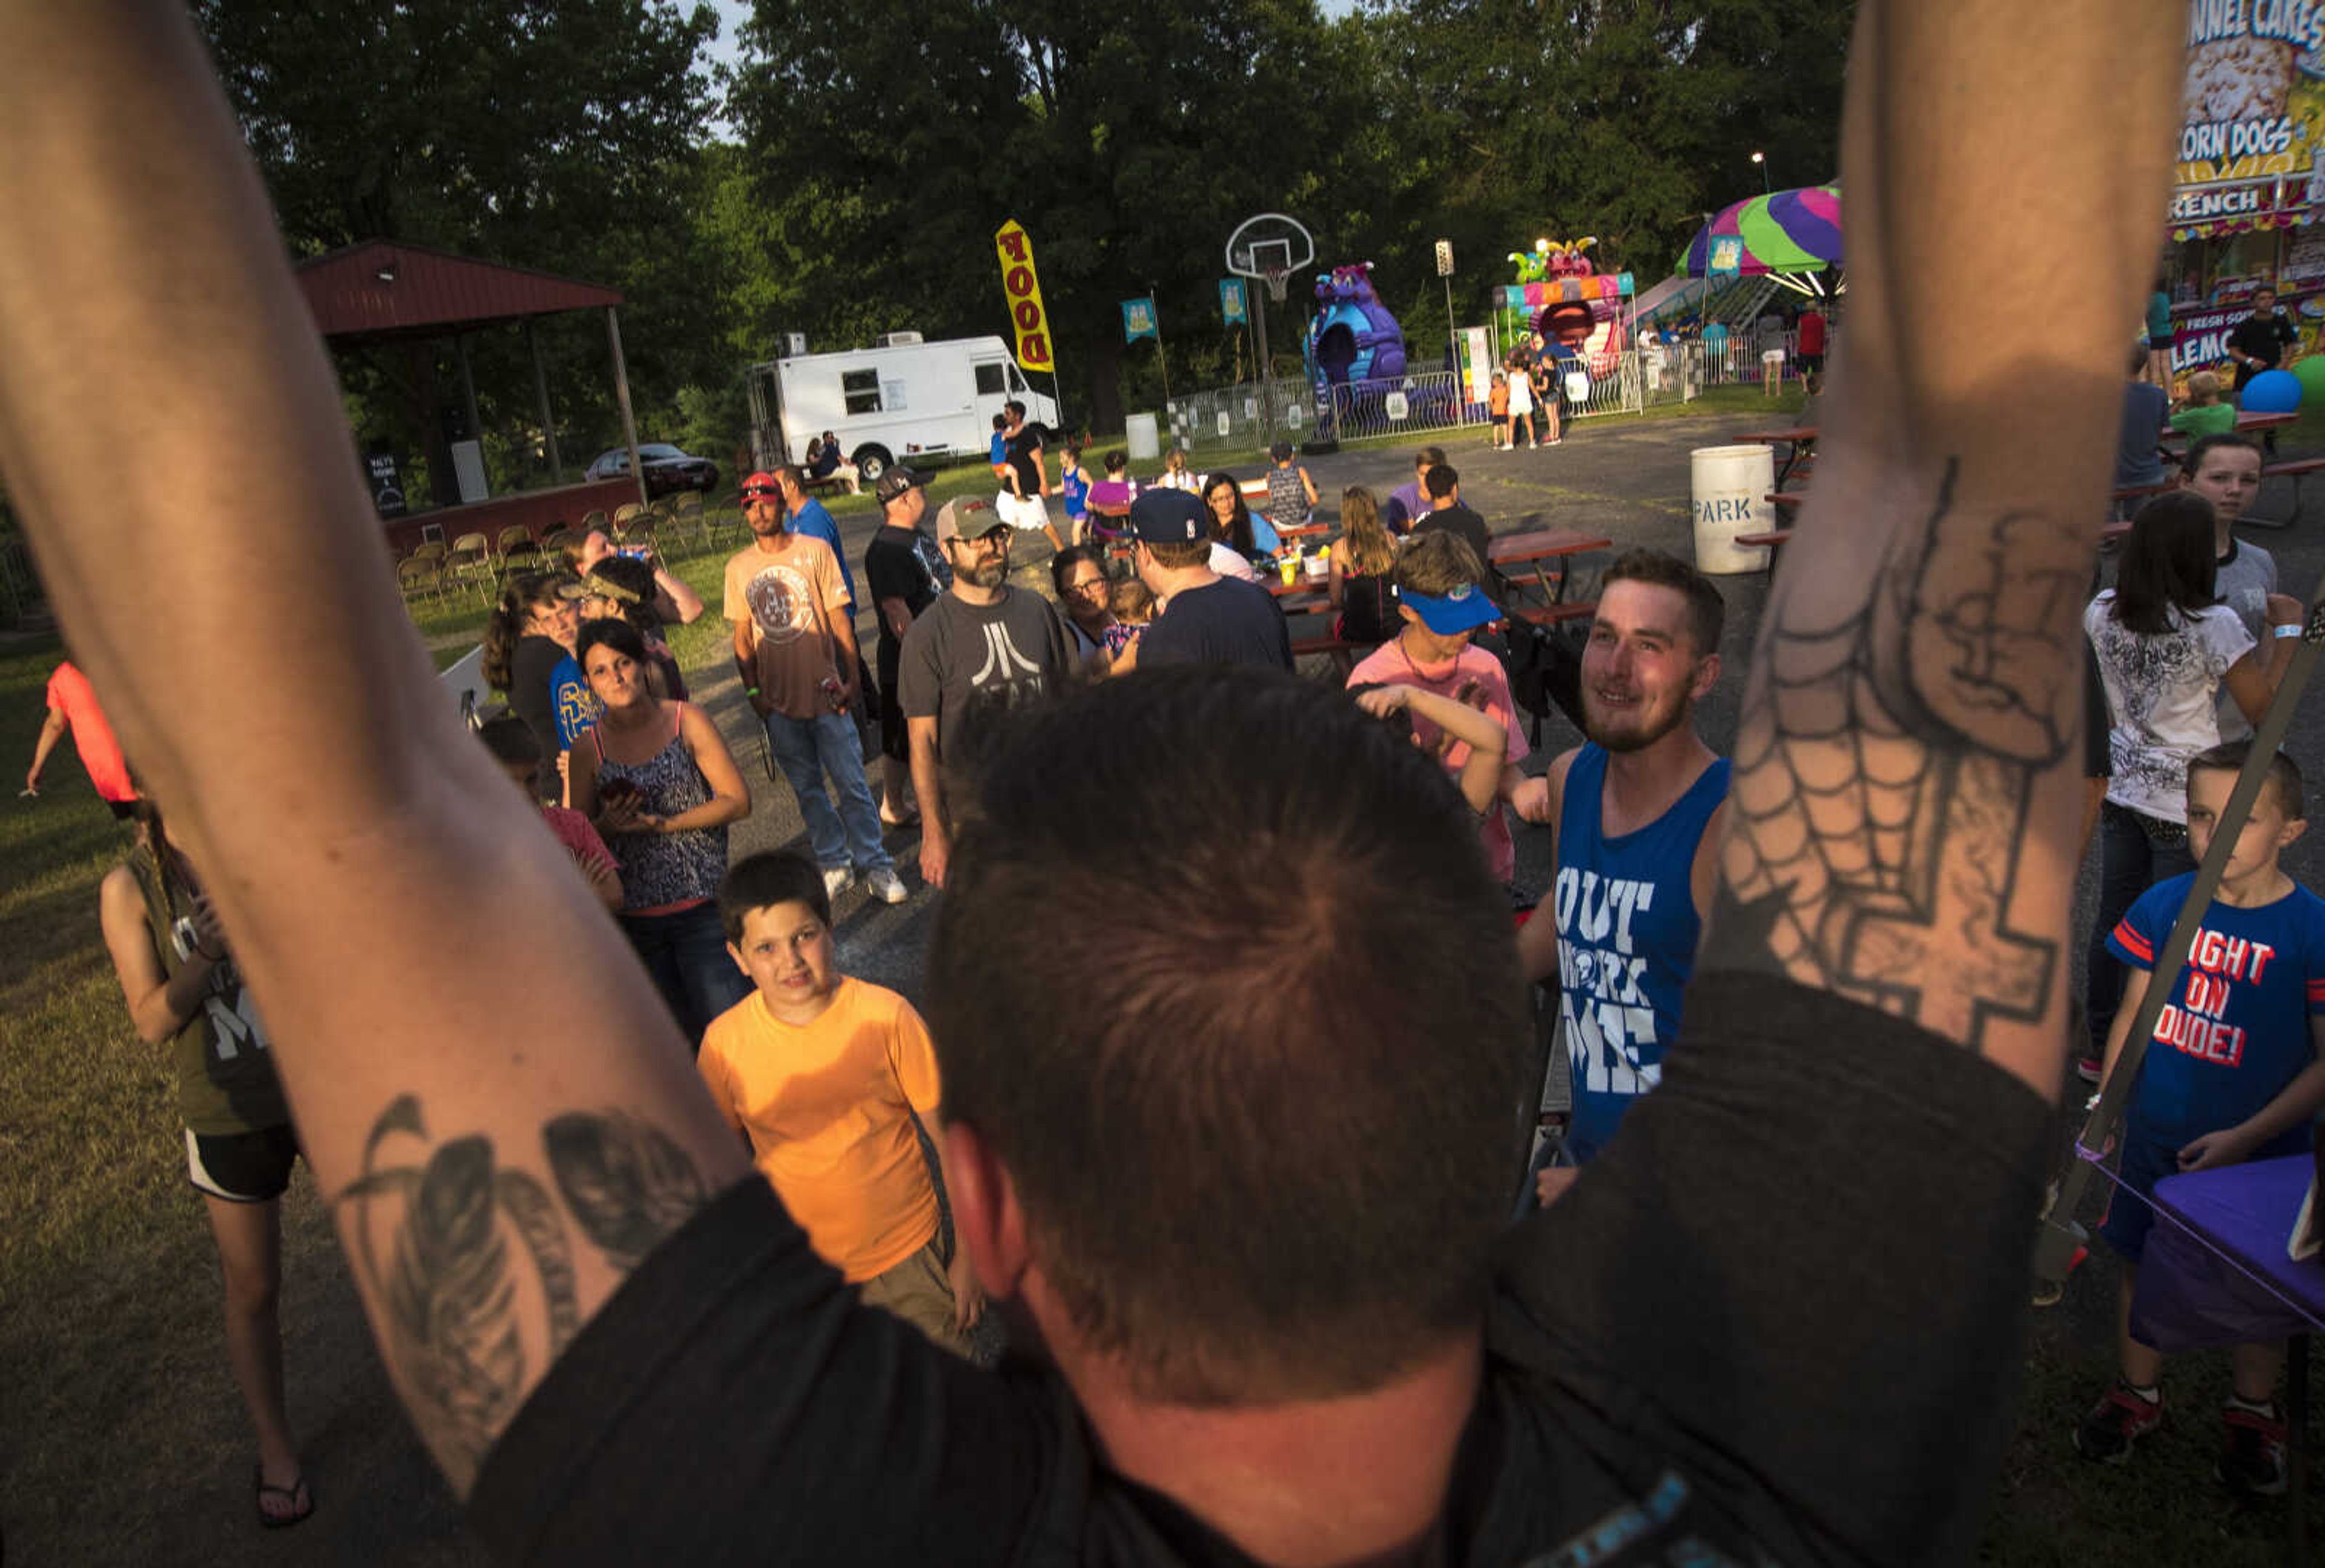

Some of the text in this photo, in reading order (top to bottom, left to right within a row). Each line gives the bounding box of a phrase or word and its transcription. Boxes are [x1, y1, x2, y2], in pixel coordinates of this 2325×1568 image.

[2188, 0, 2324, 48] NNEL CAKES
[2181, 116, 2292, 162] ORN DOGS
[2169, 189, 2259, 219] RENCH
[2187, 314, 2224, 331] FRESH
[2171, 330, 2234, 372] LEMO
[1692, 497, 1752, 524] PARK
[1554, 866, 1656, 955] OUT
[2188, 926, 2275, 984] IGHT
[2186, 972, 2230, 1020] ON
[2154, 1004, 2245, 1067] DUDE!
